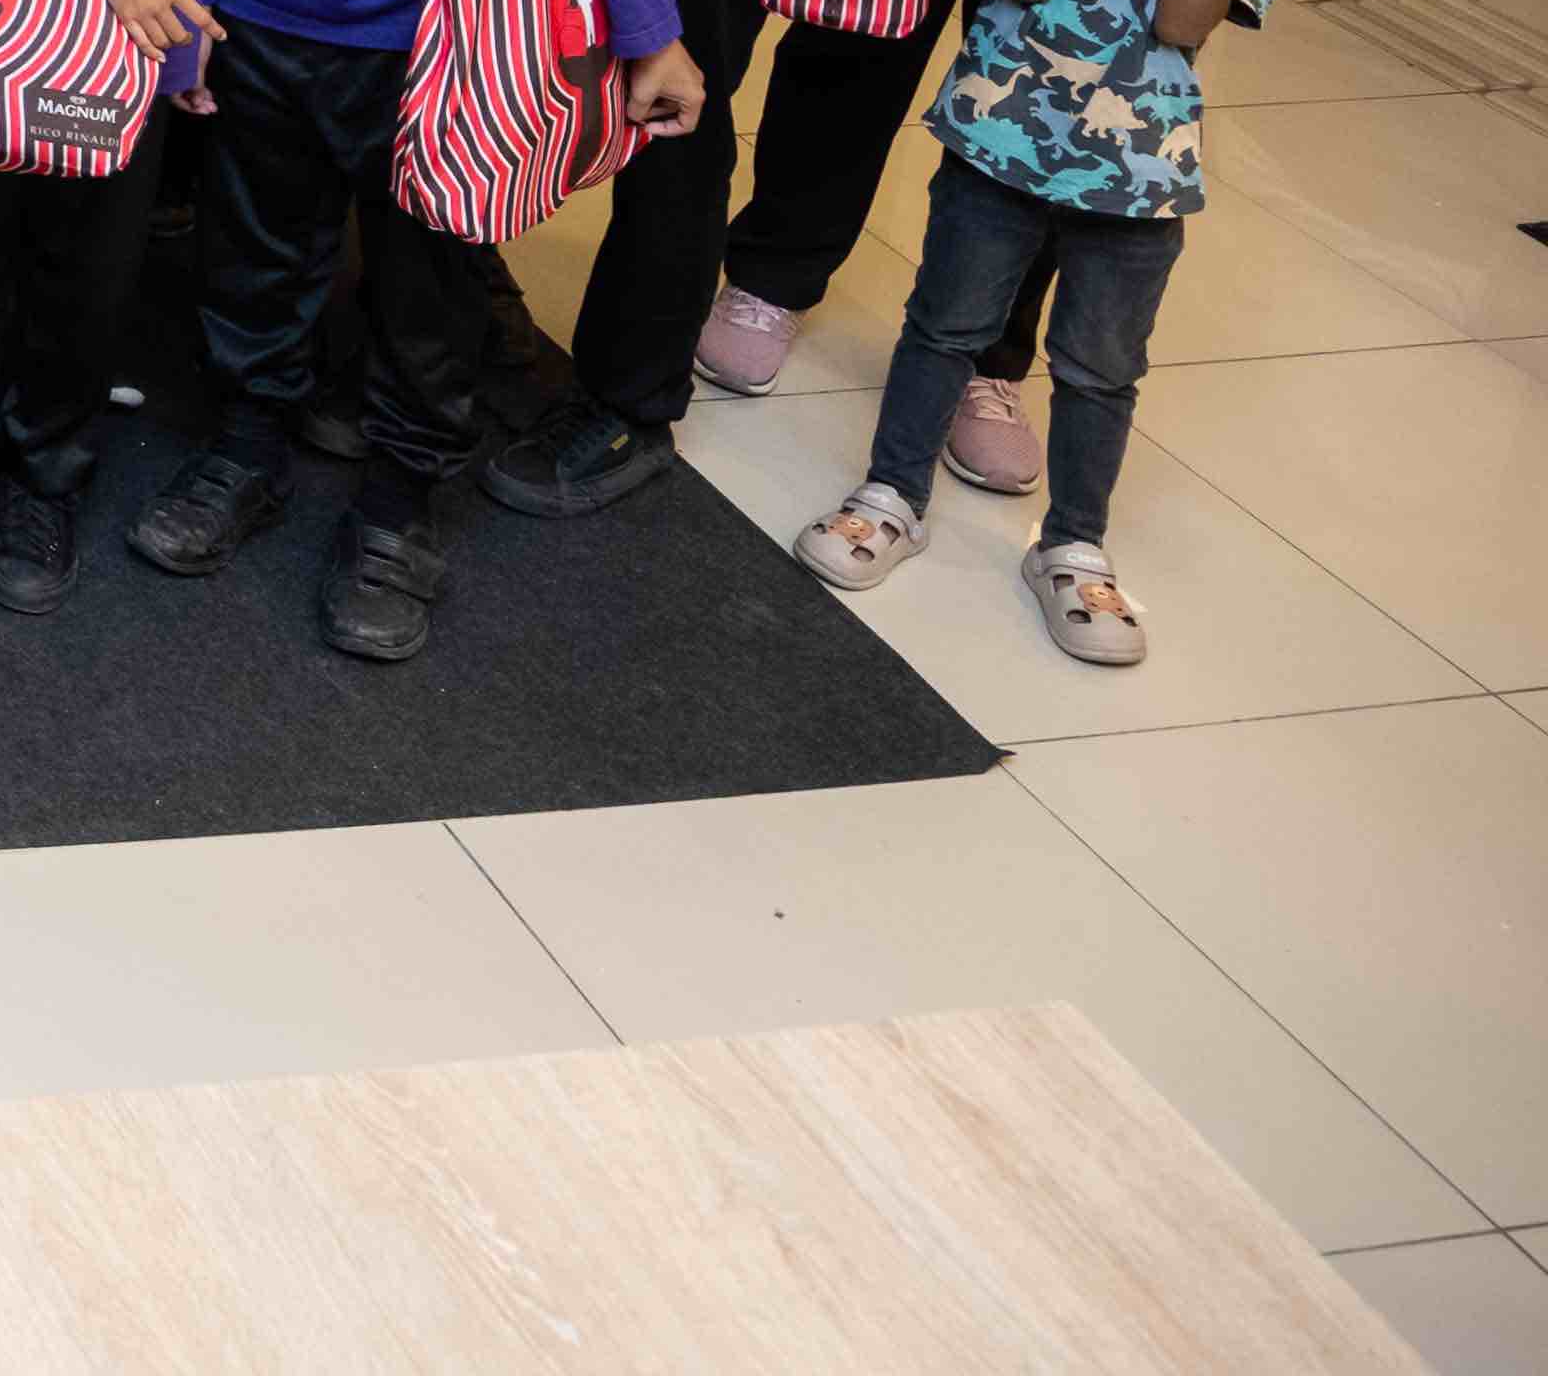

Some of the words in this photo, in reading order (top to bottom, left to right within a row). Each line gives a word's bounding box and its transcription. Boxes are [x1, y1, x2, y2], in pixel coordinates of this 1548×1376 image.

[37, 96, 117, 124] MAGNUM
[30, 125, 61, 138] RICO
[65, 130, 121, 148] RINALDI
